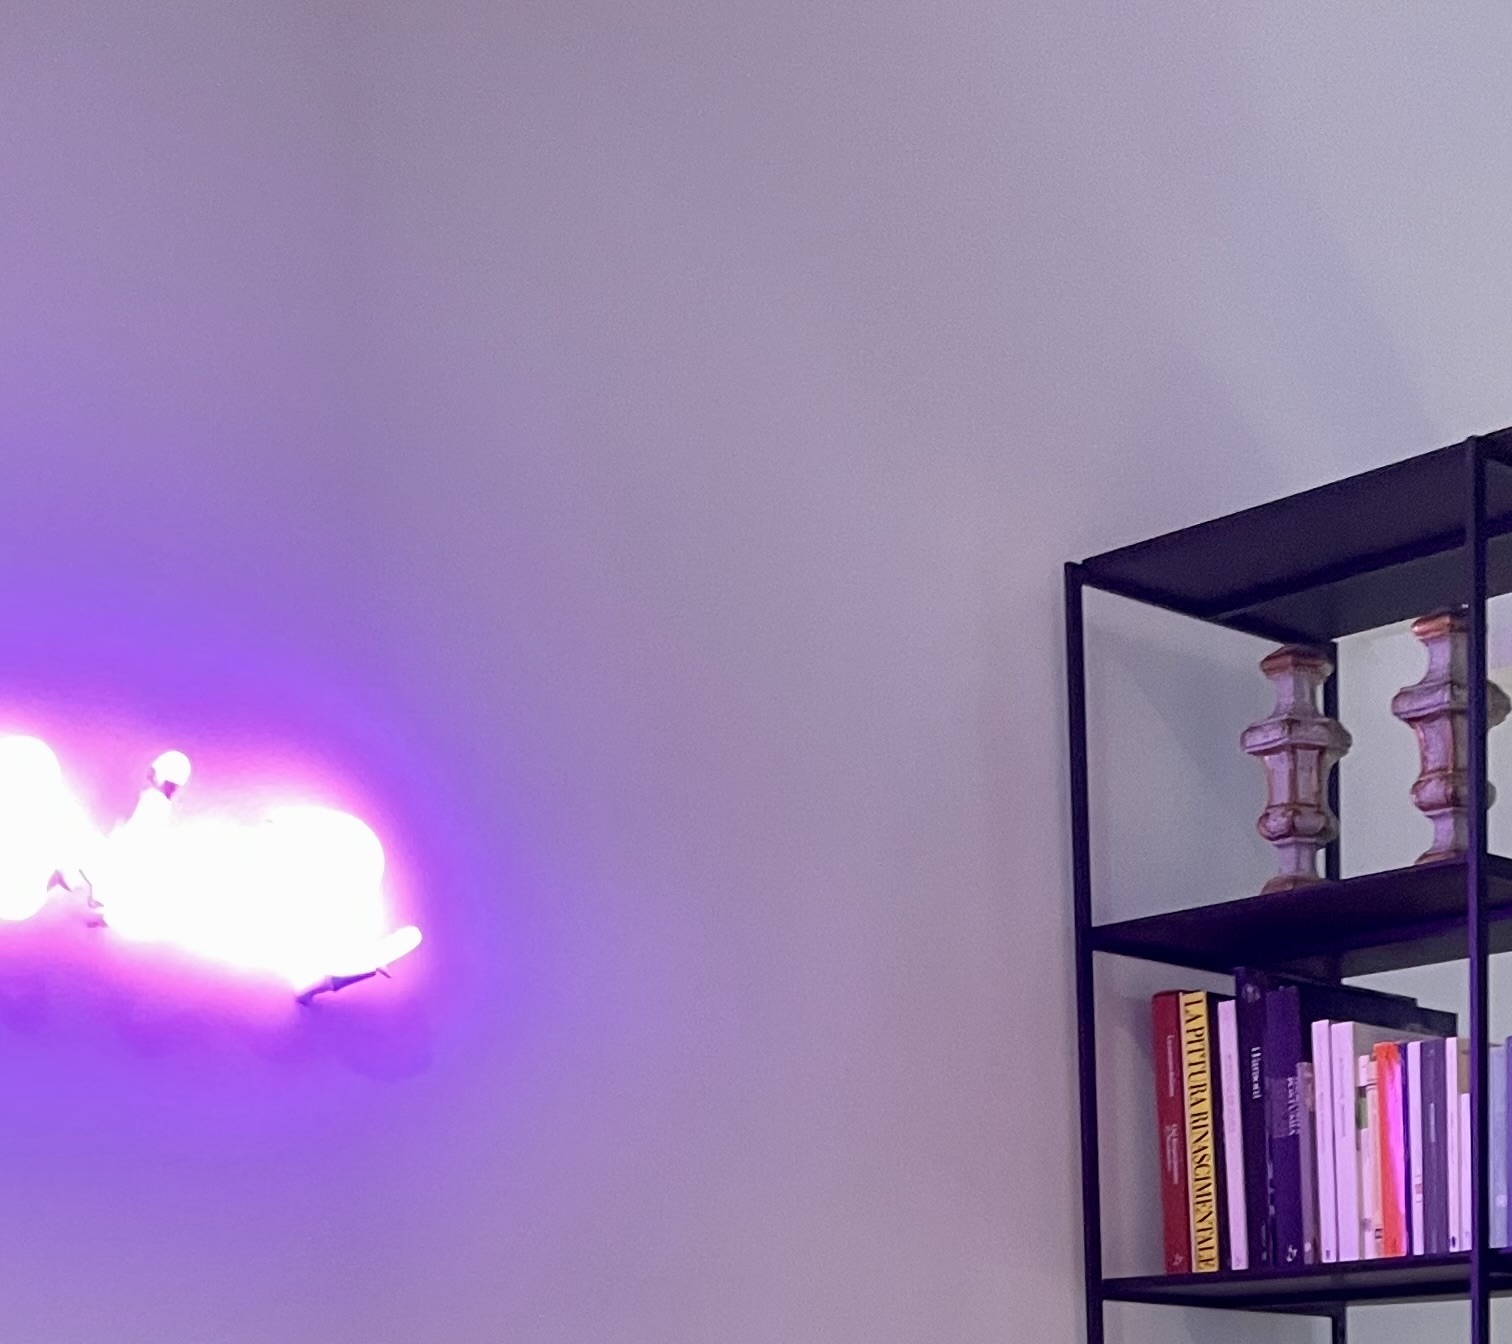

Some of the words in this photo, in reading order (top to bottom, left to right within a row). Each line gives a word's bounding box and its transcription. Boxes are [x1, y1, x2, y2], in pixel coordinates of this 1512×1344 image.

[1184, 1000, 1206, 1023] LA
[1185, 1026, 1210, 1107] PITTURA
[1190, 1111, 1217, 1272] RINASCIMENTALE
